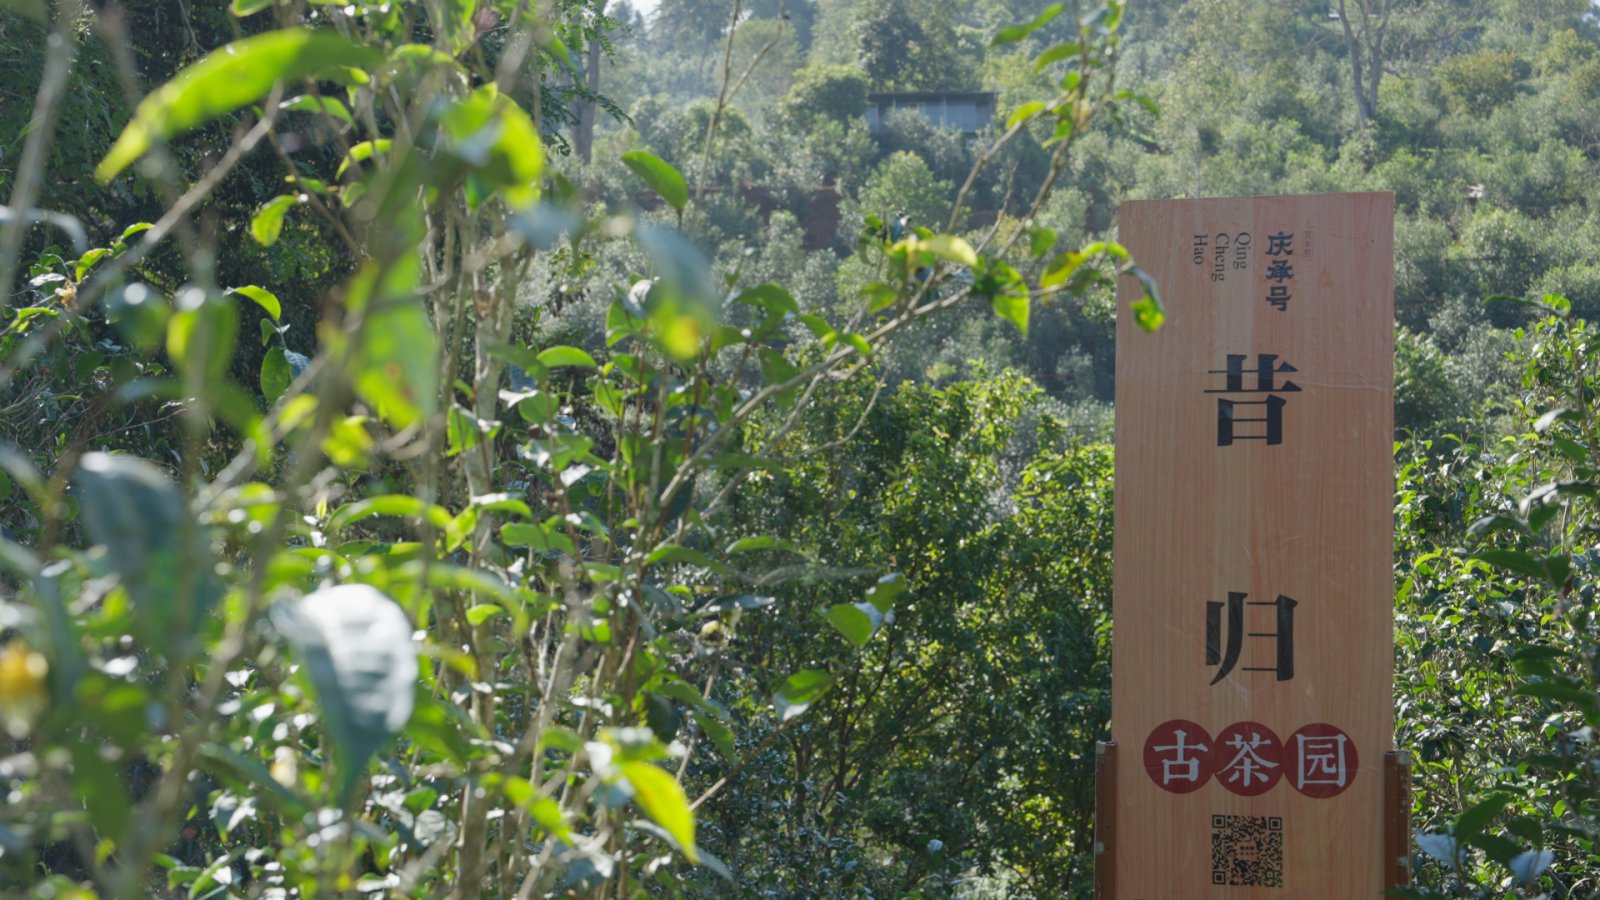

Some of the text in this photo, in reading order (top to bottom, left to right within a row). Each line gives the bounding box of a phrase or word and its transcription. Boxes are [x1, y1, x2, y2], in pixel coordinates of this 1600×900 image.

[1193, 234, 1208, 265] Hao
[1211, 233, 1230, 282] Cheng
[1232, 232, 1252, 270] Qing
[1265, 231, 1294, 312] 庆承号
[1204, 353, 1303, 686] 昔归
[1153, 729, 1348, 790] 古茶园
